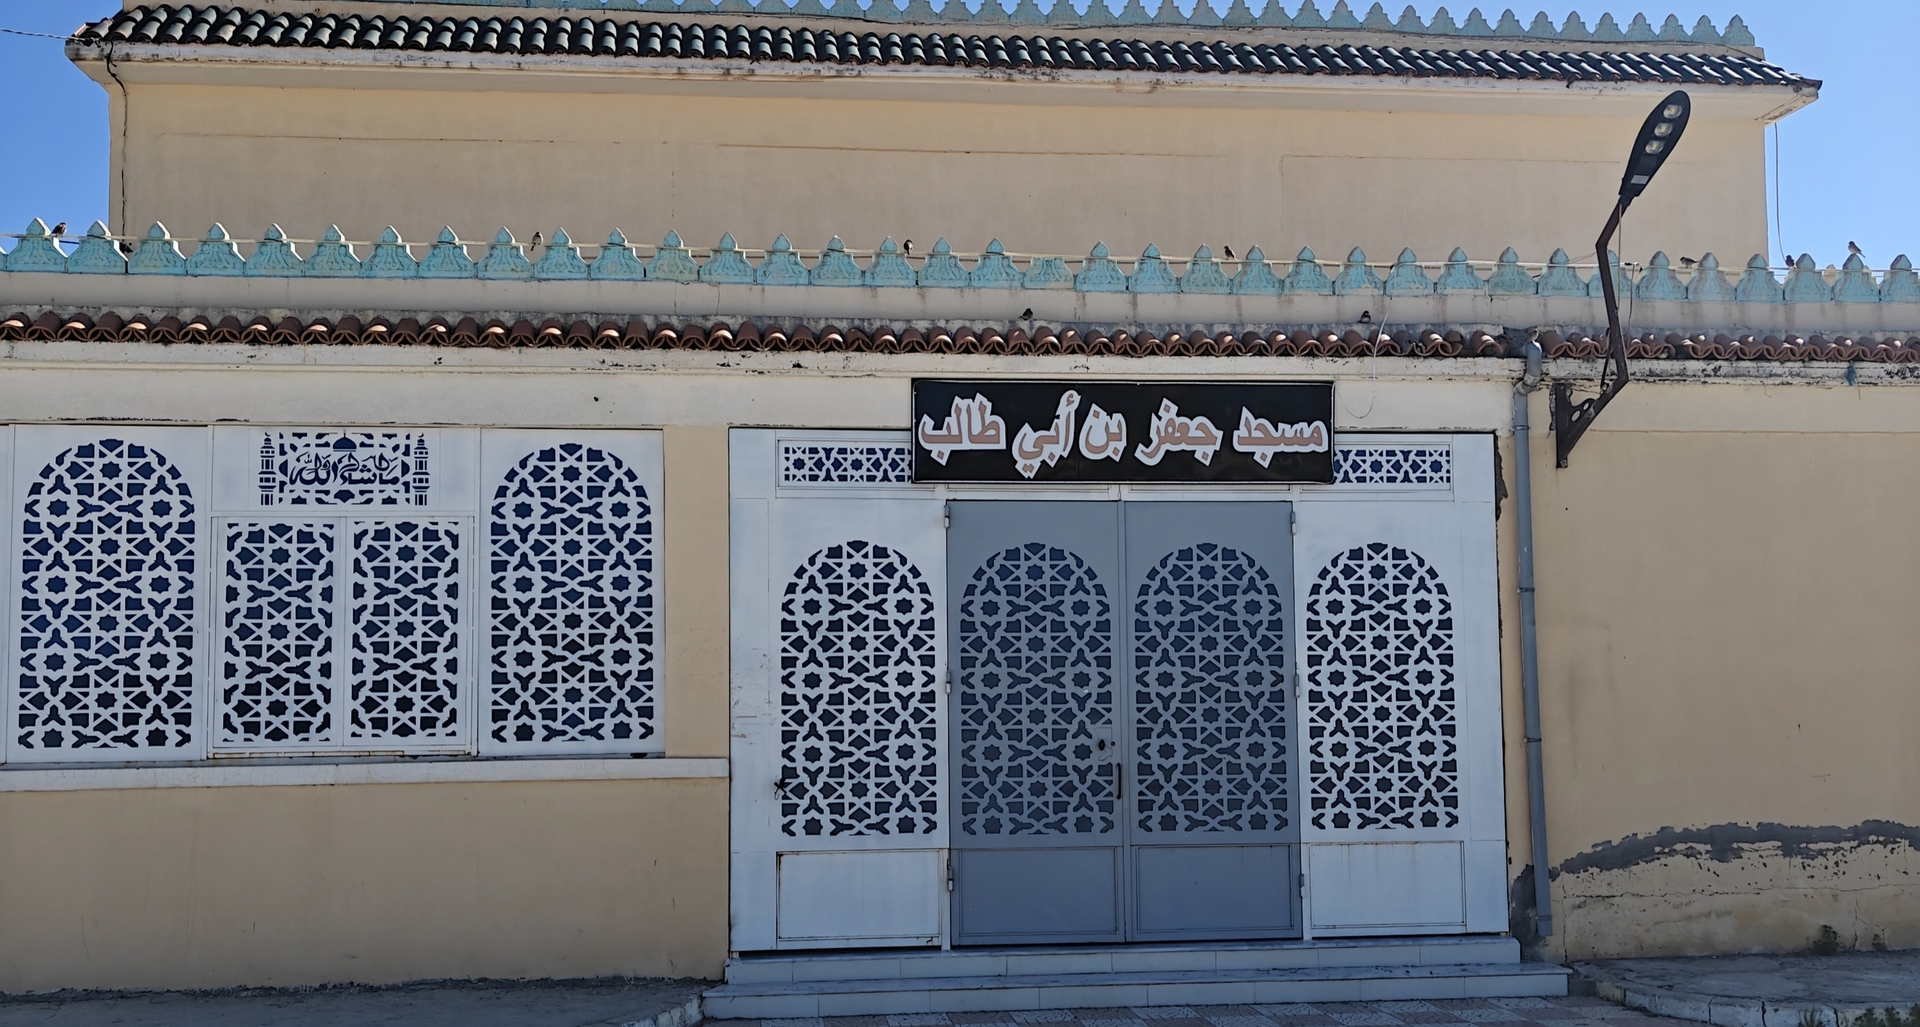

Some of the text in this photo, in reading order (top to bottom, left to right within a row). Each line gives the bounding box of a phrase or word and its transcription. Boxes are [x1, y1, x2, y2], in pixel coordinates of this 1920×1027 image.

[919, 390, 1329, 478] مسجد جعفر بن أبي طالب
